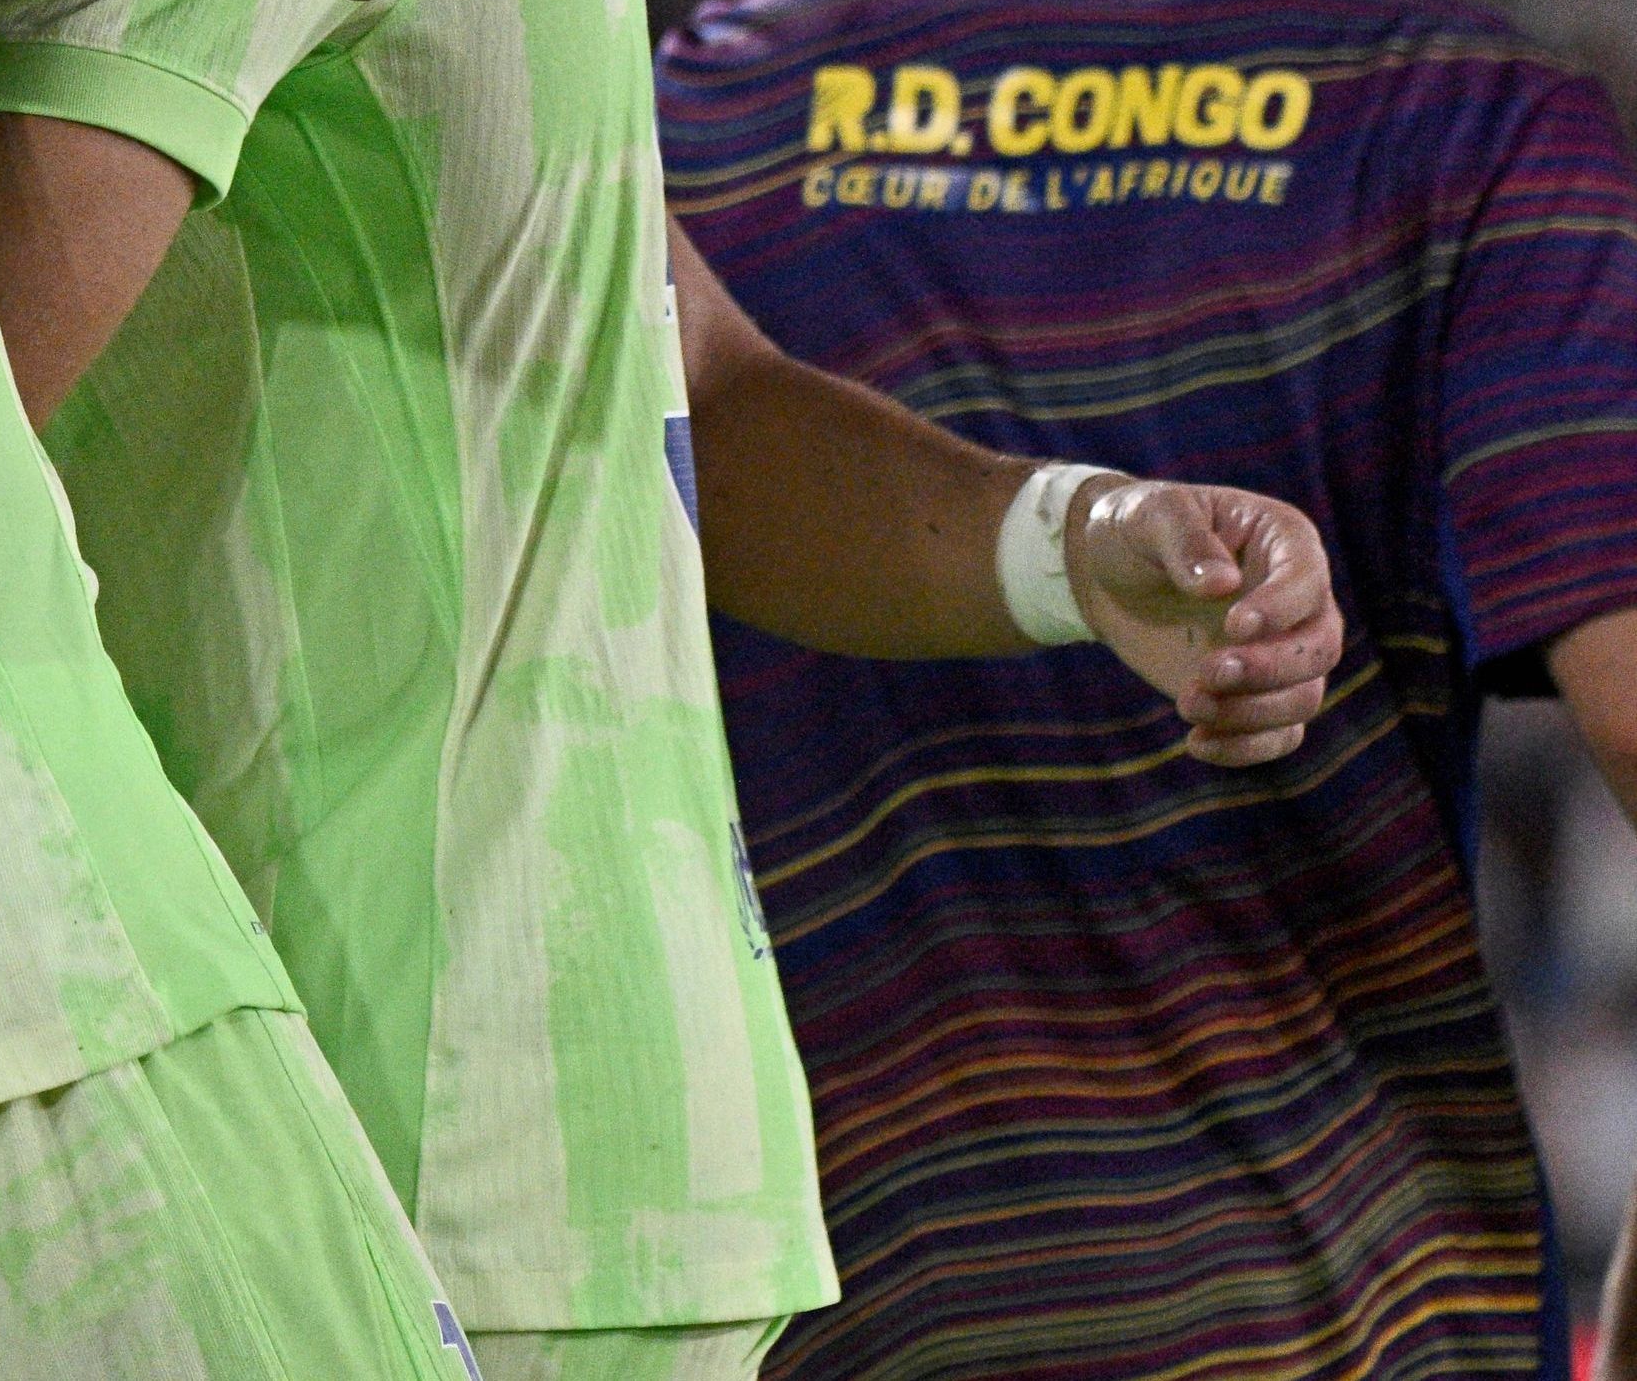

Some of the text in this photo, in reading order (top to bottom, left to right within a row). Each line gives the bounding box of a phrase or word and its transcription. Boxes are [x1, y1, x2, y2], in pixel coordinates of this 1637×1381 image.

[806, 63, 1313, 157] R.D. CONGO
[967, 169, 1037, 213] DE
[1044, 158, 1293, 211] L'AFRIQUE
